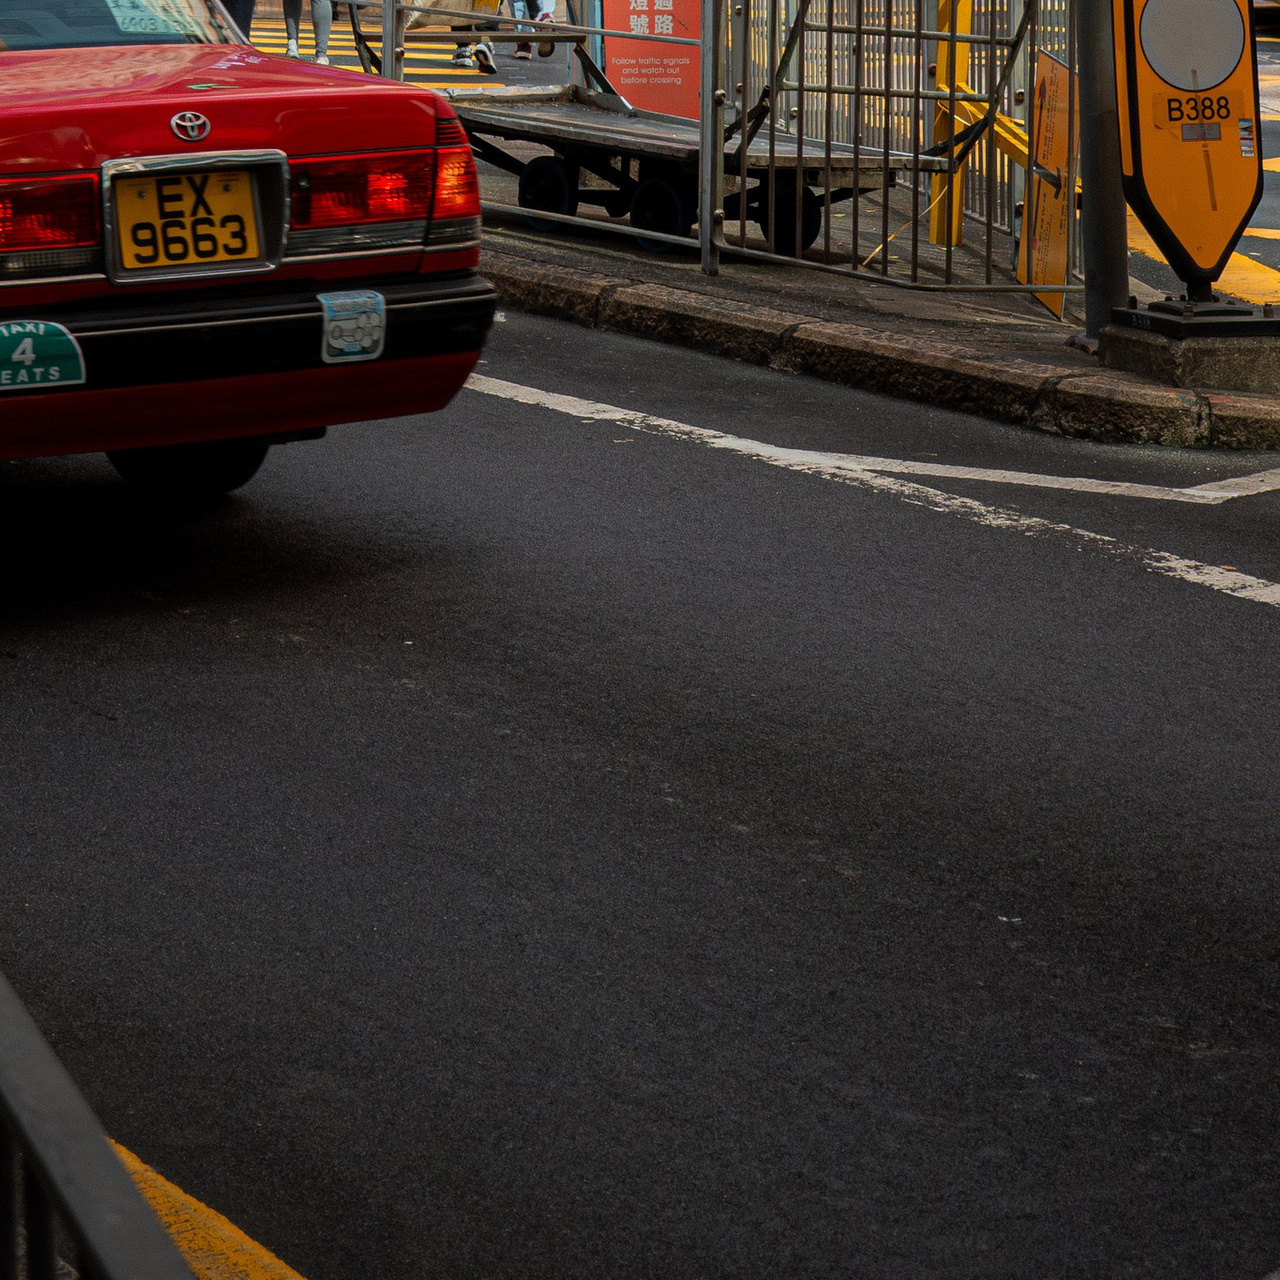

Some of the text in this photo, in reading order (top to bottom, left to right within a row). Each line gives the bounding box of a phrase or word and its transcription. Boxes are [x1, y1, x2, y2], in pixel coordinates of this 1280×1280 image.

[612, 57, 690, 67] Follow traffic signals
[641, 67, 665, 75] watch
[621, 76, 682, 86] before crossing
[1167, 96, 1230, 122] B388
[156, 175, 214, 220] EX
[131, 214, 248, 264] 9663
[11, 337, 36, 366] 4
